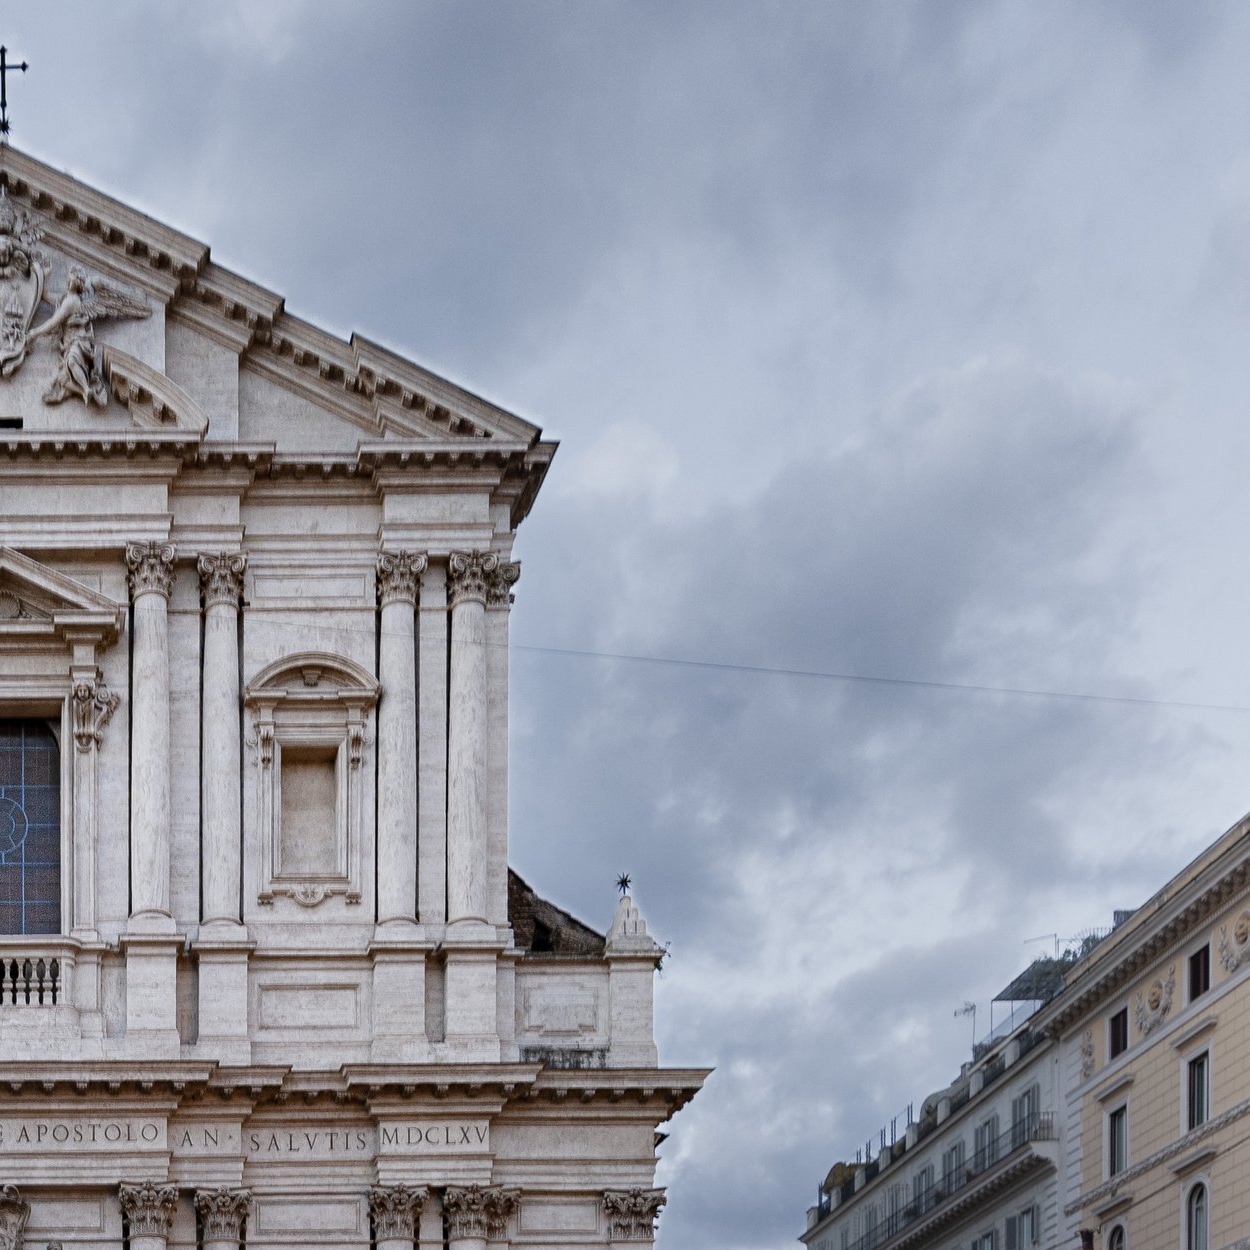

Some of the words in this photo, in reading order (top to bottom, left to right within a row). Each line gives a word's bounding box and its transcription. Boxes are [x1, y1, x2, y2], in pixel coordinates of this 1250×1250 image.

[16, 1123, 159, 1143] APOSTOLO
[250, 1132, 367, 1152] SALVTIS
[381, 1126, 488, 1145] MDCLXV
